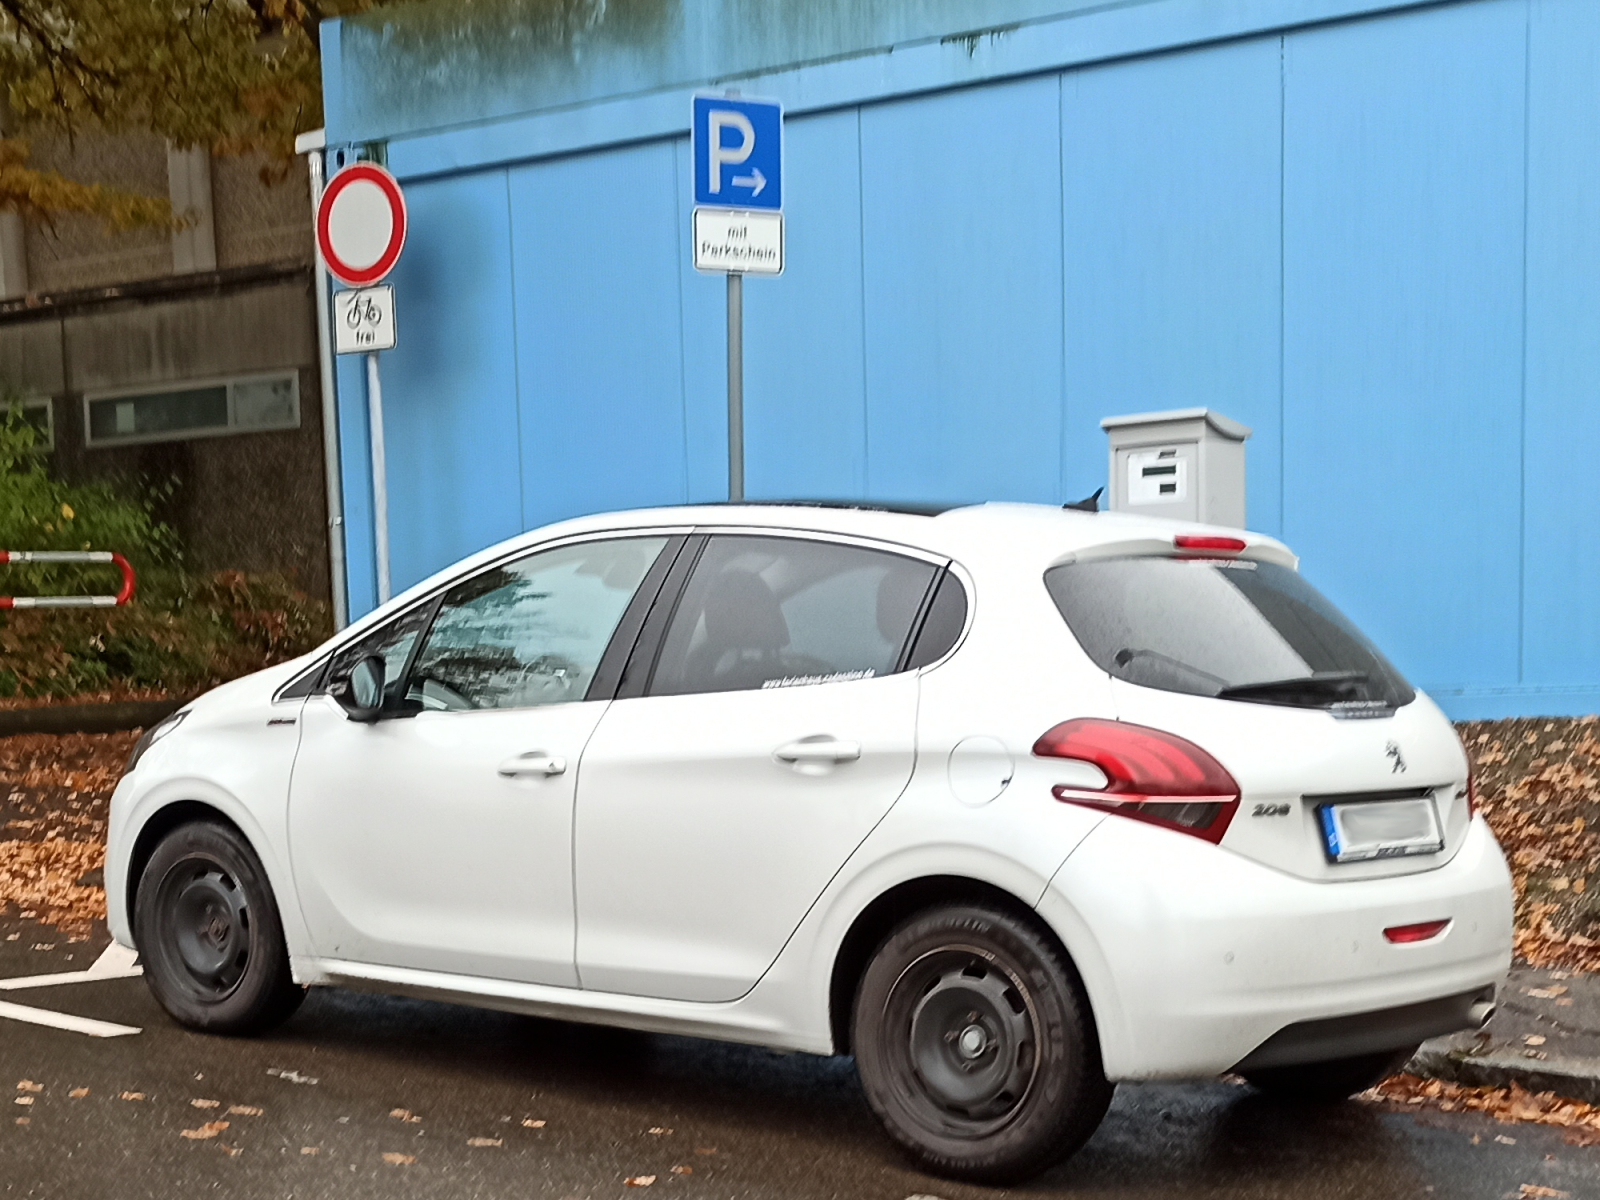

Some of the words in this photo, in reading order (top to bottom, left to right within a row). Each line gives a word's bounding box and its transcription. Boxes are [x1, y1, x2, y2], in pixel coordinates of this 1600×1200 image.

[709, 110, 755, 194] P
[727, 226, 748, 239] mit
[702, 241, 776, 260] Parkschein
[356, 330, 375, 345] frei
